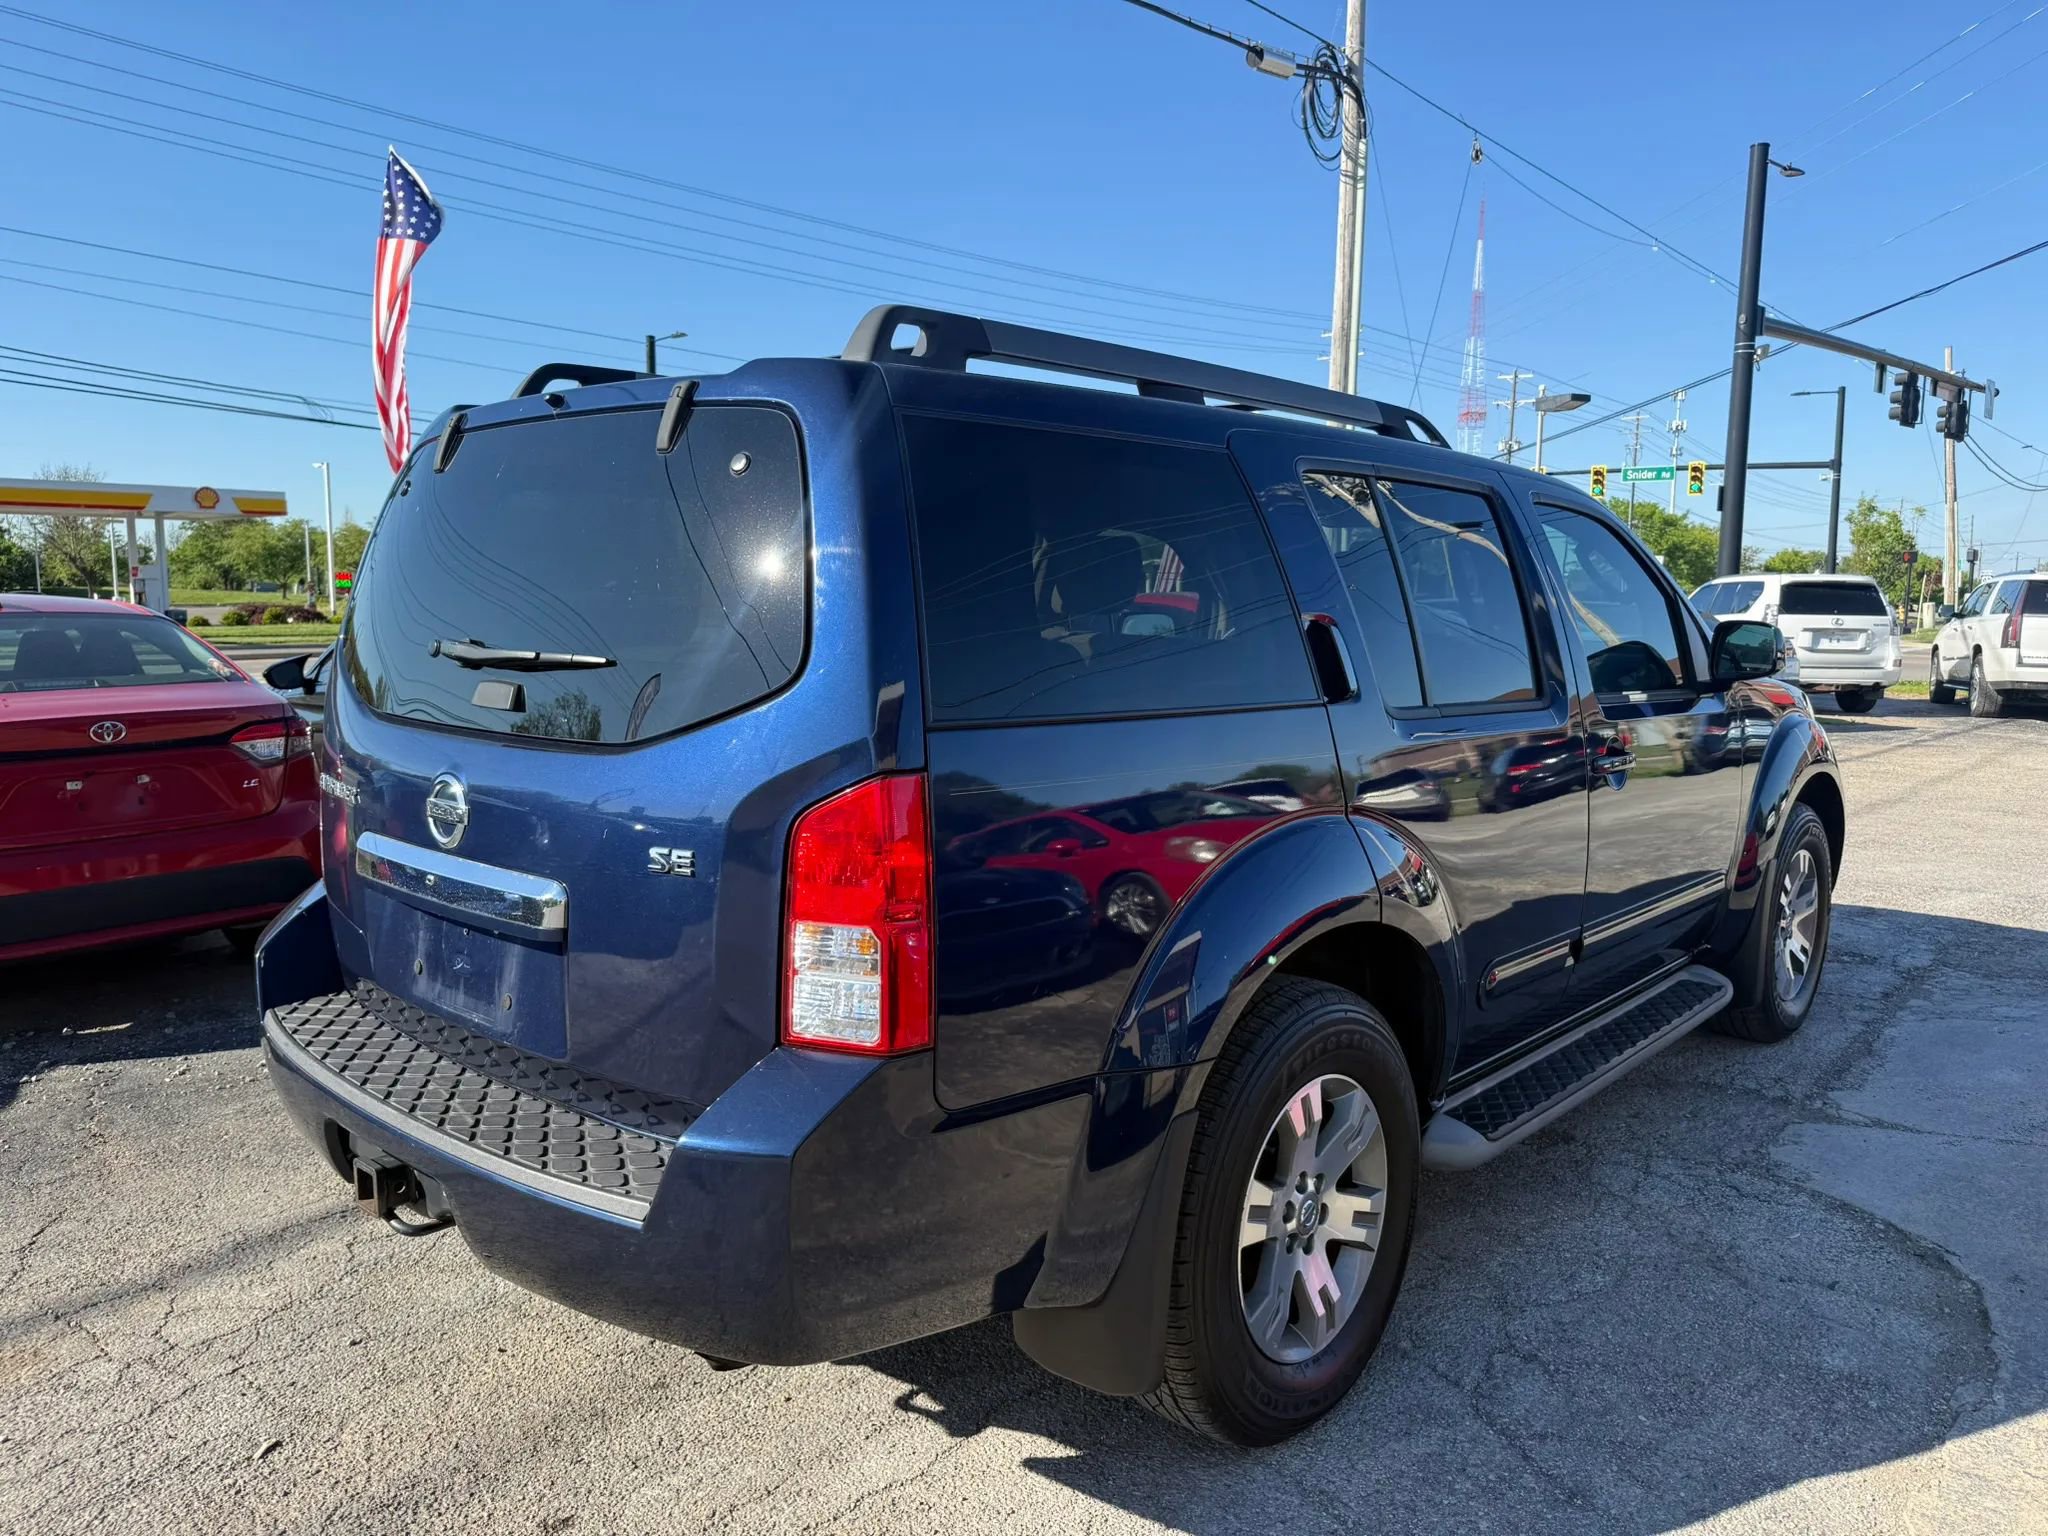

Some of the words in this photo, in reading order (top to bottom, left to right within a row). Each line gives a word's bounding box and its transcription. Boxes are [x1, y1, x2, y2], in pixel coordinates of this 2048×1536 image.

[1626, 469, 1657, 480] Snider
[1661, 471, 1671, 479] Rd
[647, 846, 696, 878] SE
